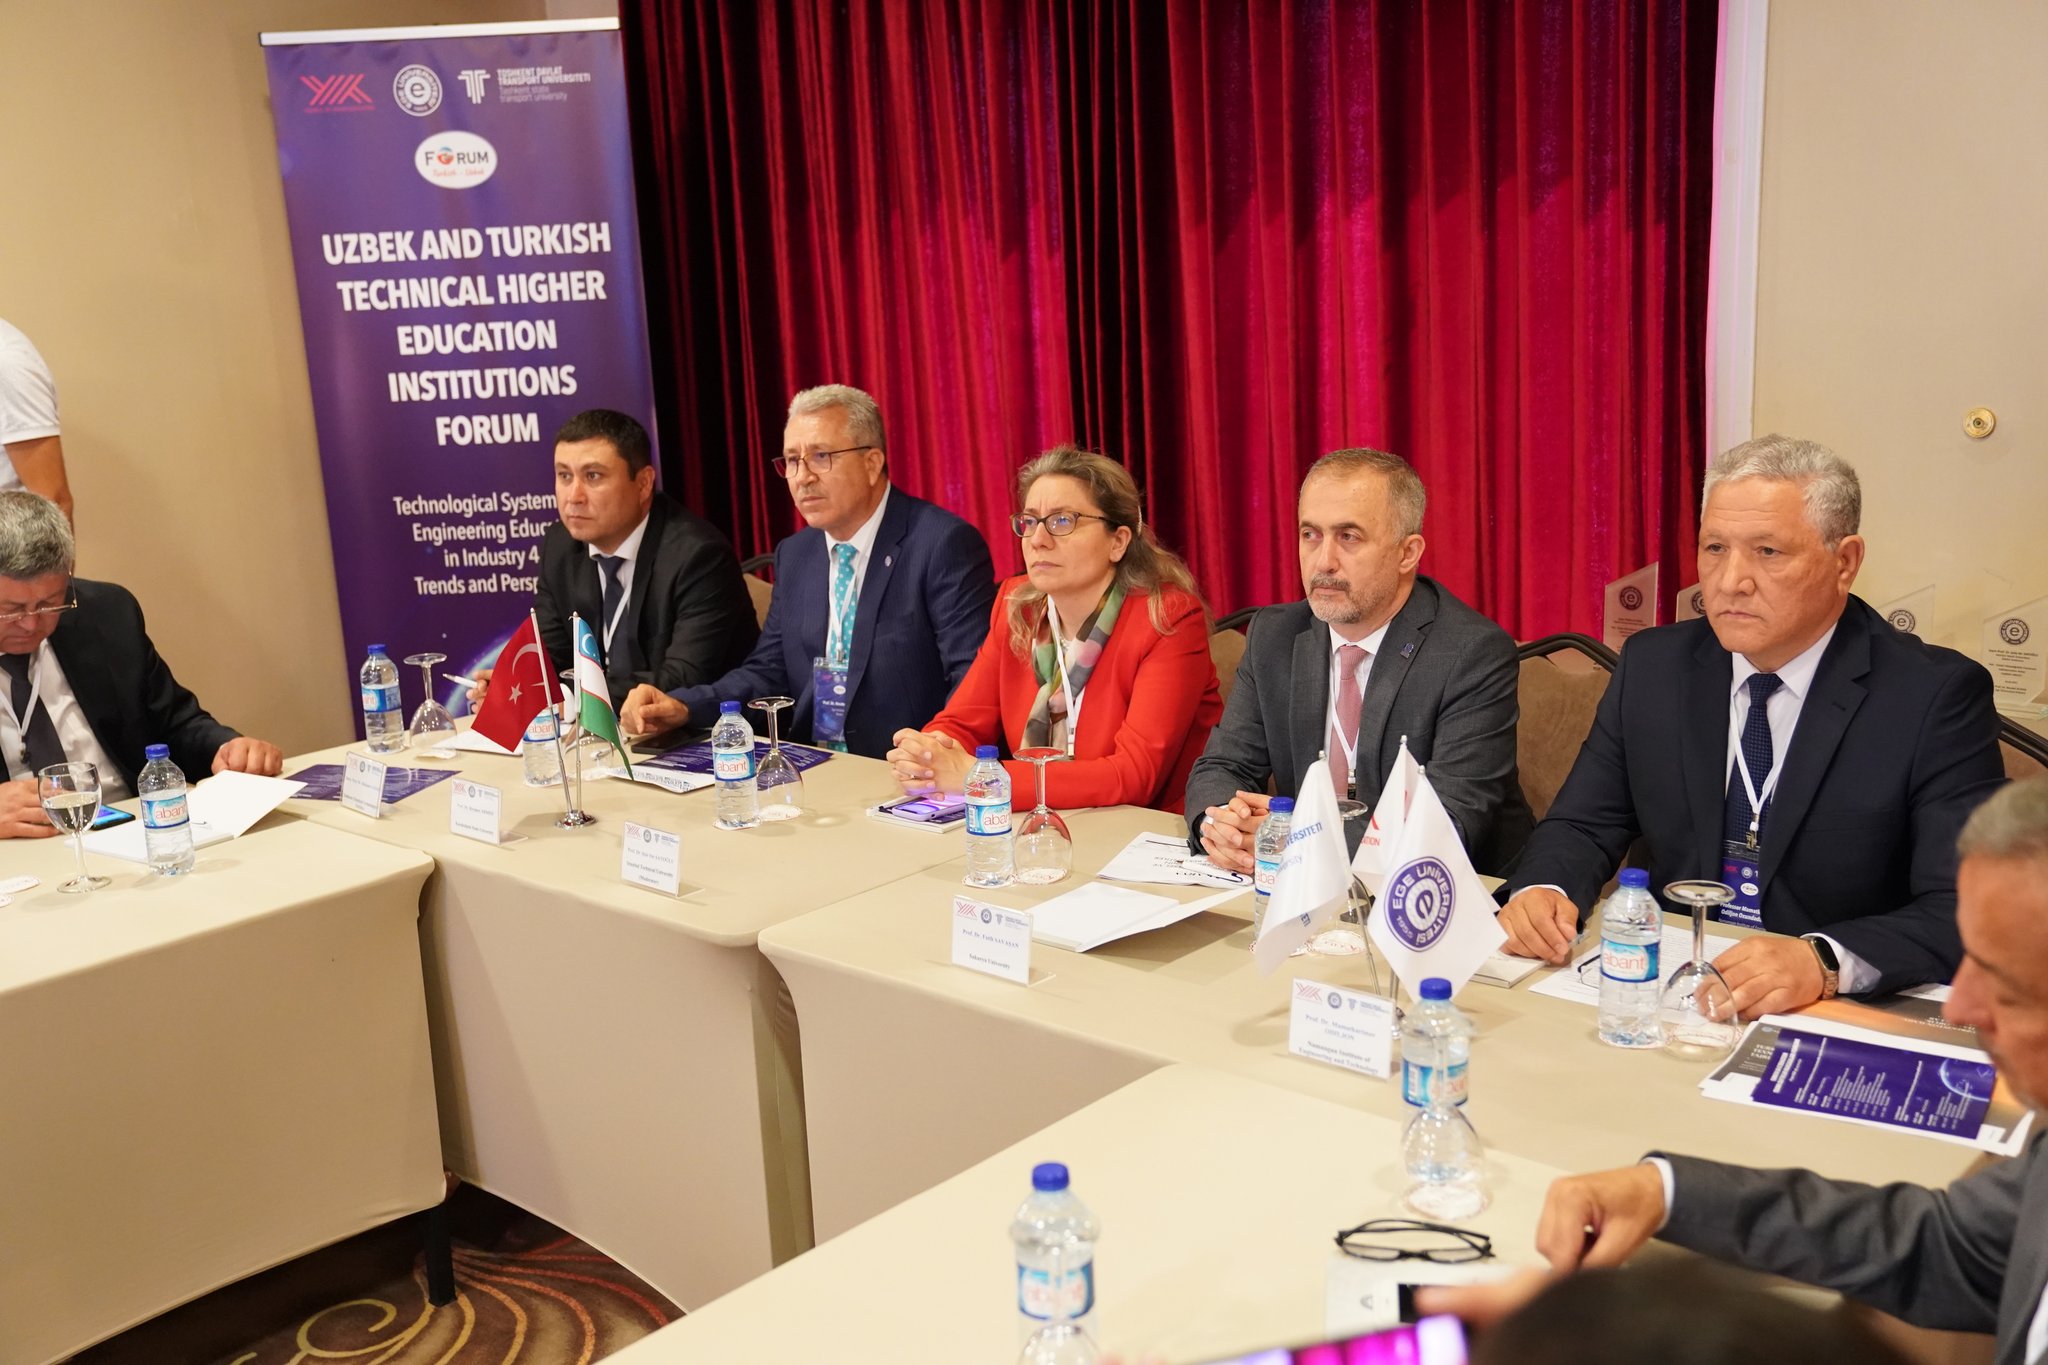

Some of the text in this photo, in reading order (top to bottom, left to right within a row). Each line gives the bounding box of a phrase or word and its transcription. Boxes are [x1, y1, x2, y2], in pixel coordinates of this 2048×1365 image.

[321, 221, 612, 266] UZBEK AND TURKISH
[336, 270, 608, 312] TECHNICAL HIGHER
[397, 319, 558, 356] EDUCATION
[387, 364, 578, 402] INSTITUTIONS
[435, 413, 540, 446] FORUM
[393, 491, 558, 518] Technological System
[412, 521, 507, 546] Engineering
[444, 549, 460, 568] in
[462, 547, 526, 570] Industry
[414, 573, 465, 596] Trends
[467, 572, 498, 594] and
[717, 760, 747, 772] abant
[1285, 822, 1323, 848] VERSITETI
[1255, 871, 1275, 885] aba
[1392, 873, 1416, 910] EGE
[1603, 950, 1645, 970] abant
